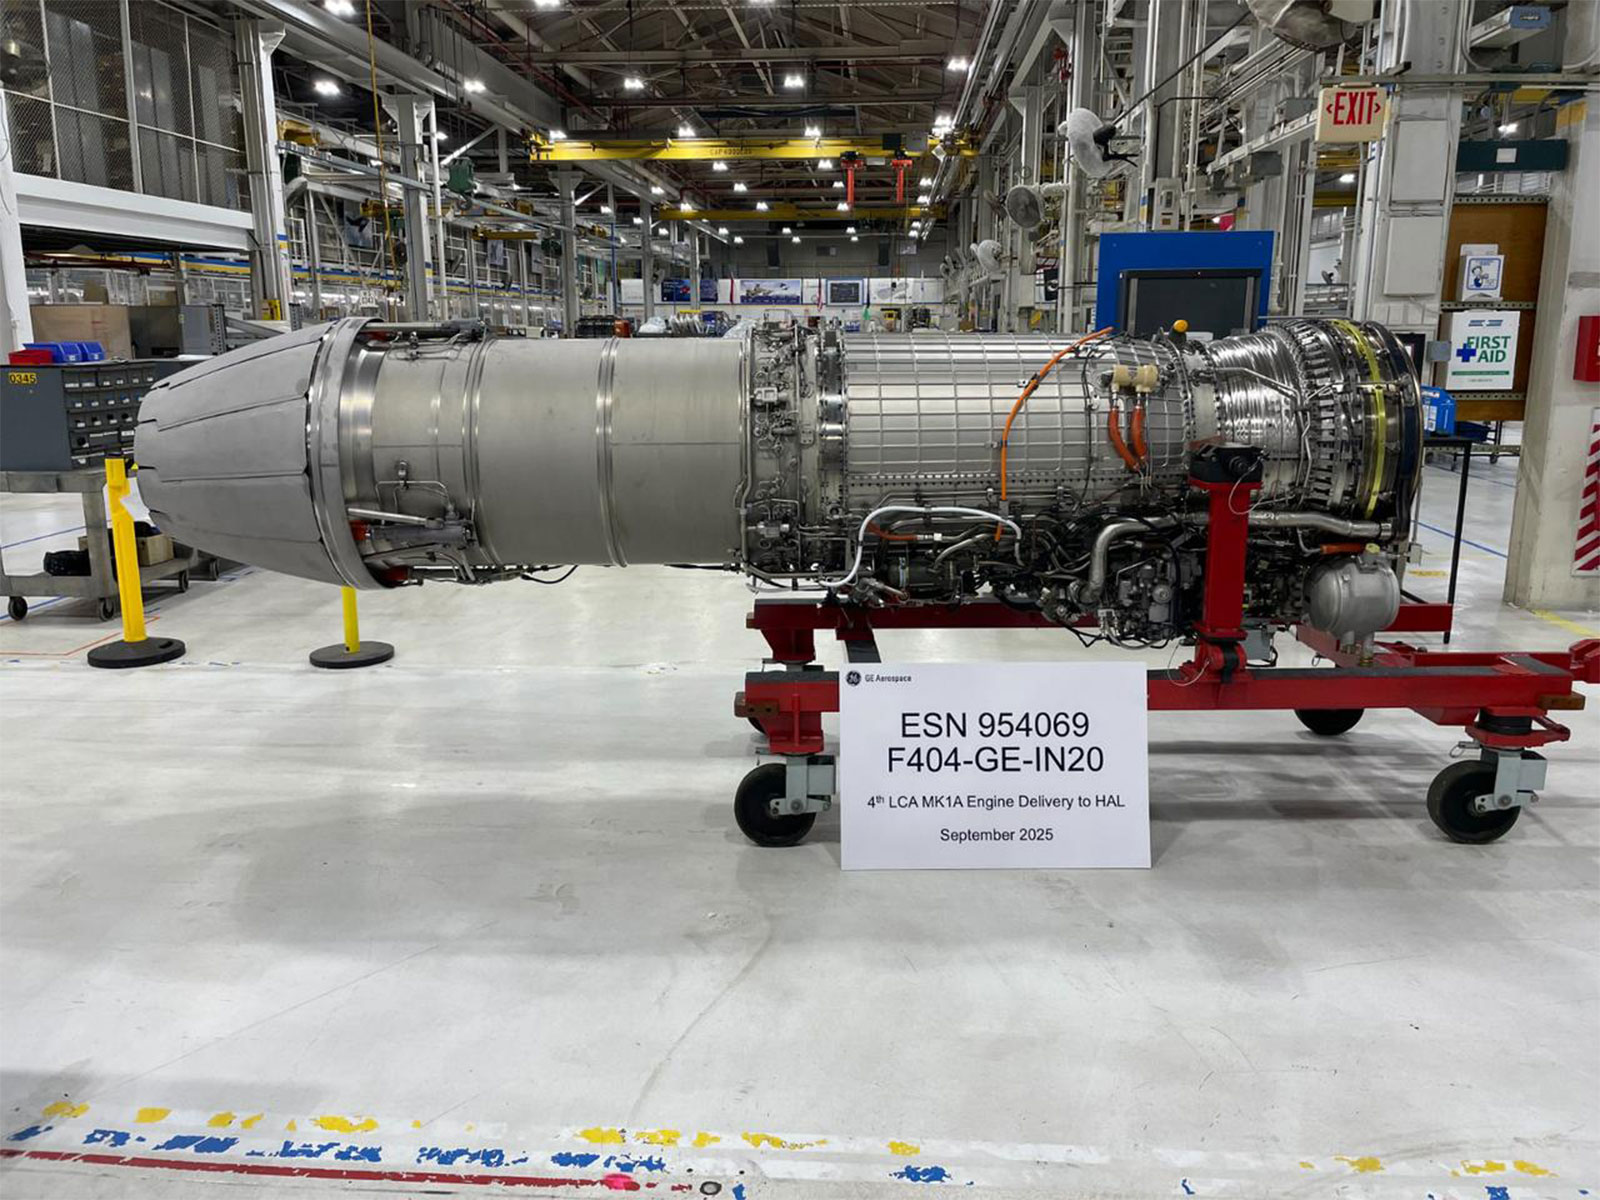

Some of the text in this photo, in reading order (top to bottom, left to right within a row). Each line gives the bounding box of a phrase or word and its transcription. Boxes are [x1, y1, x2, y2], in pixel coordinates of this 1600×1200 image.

[1333, 91, 1377, 125] EXIT
[1467, 336, 1511, 349] FIRST
[1477, 350, 1506, 363] AID
[9, 373, 36, 384] 0345
[865, 674, 874, 682] GE
[876, 674, 912, 683] Aerospace
[901, 712, 1089, 738] ESN 954069
[888, 746, 1104, 772] F404-GE-IN20
[867, 795, 1125, 811] 4th LCA MK1A Engine Delivery to HAL
[940, 828, 1053, 844] September 2025
